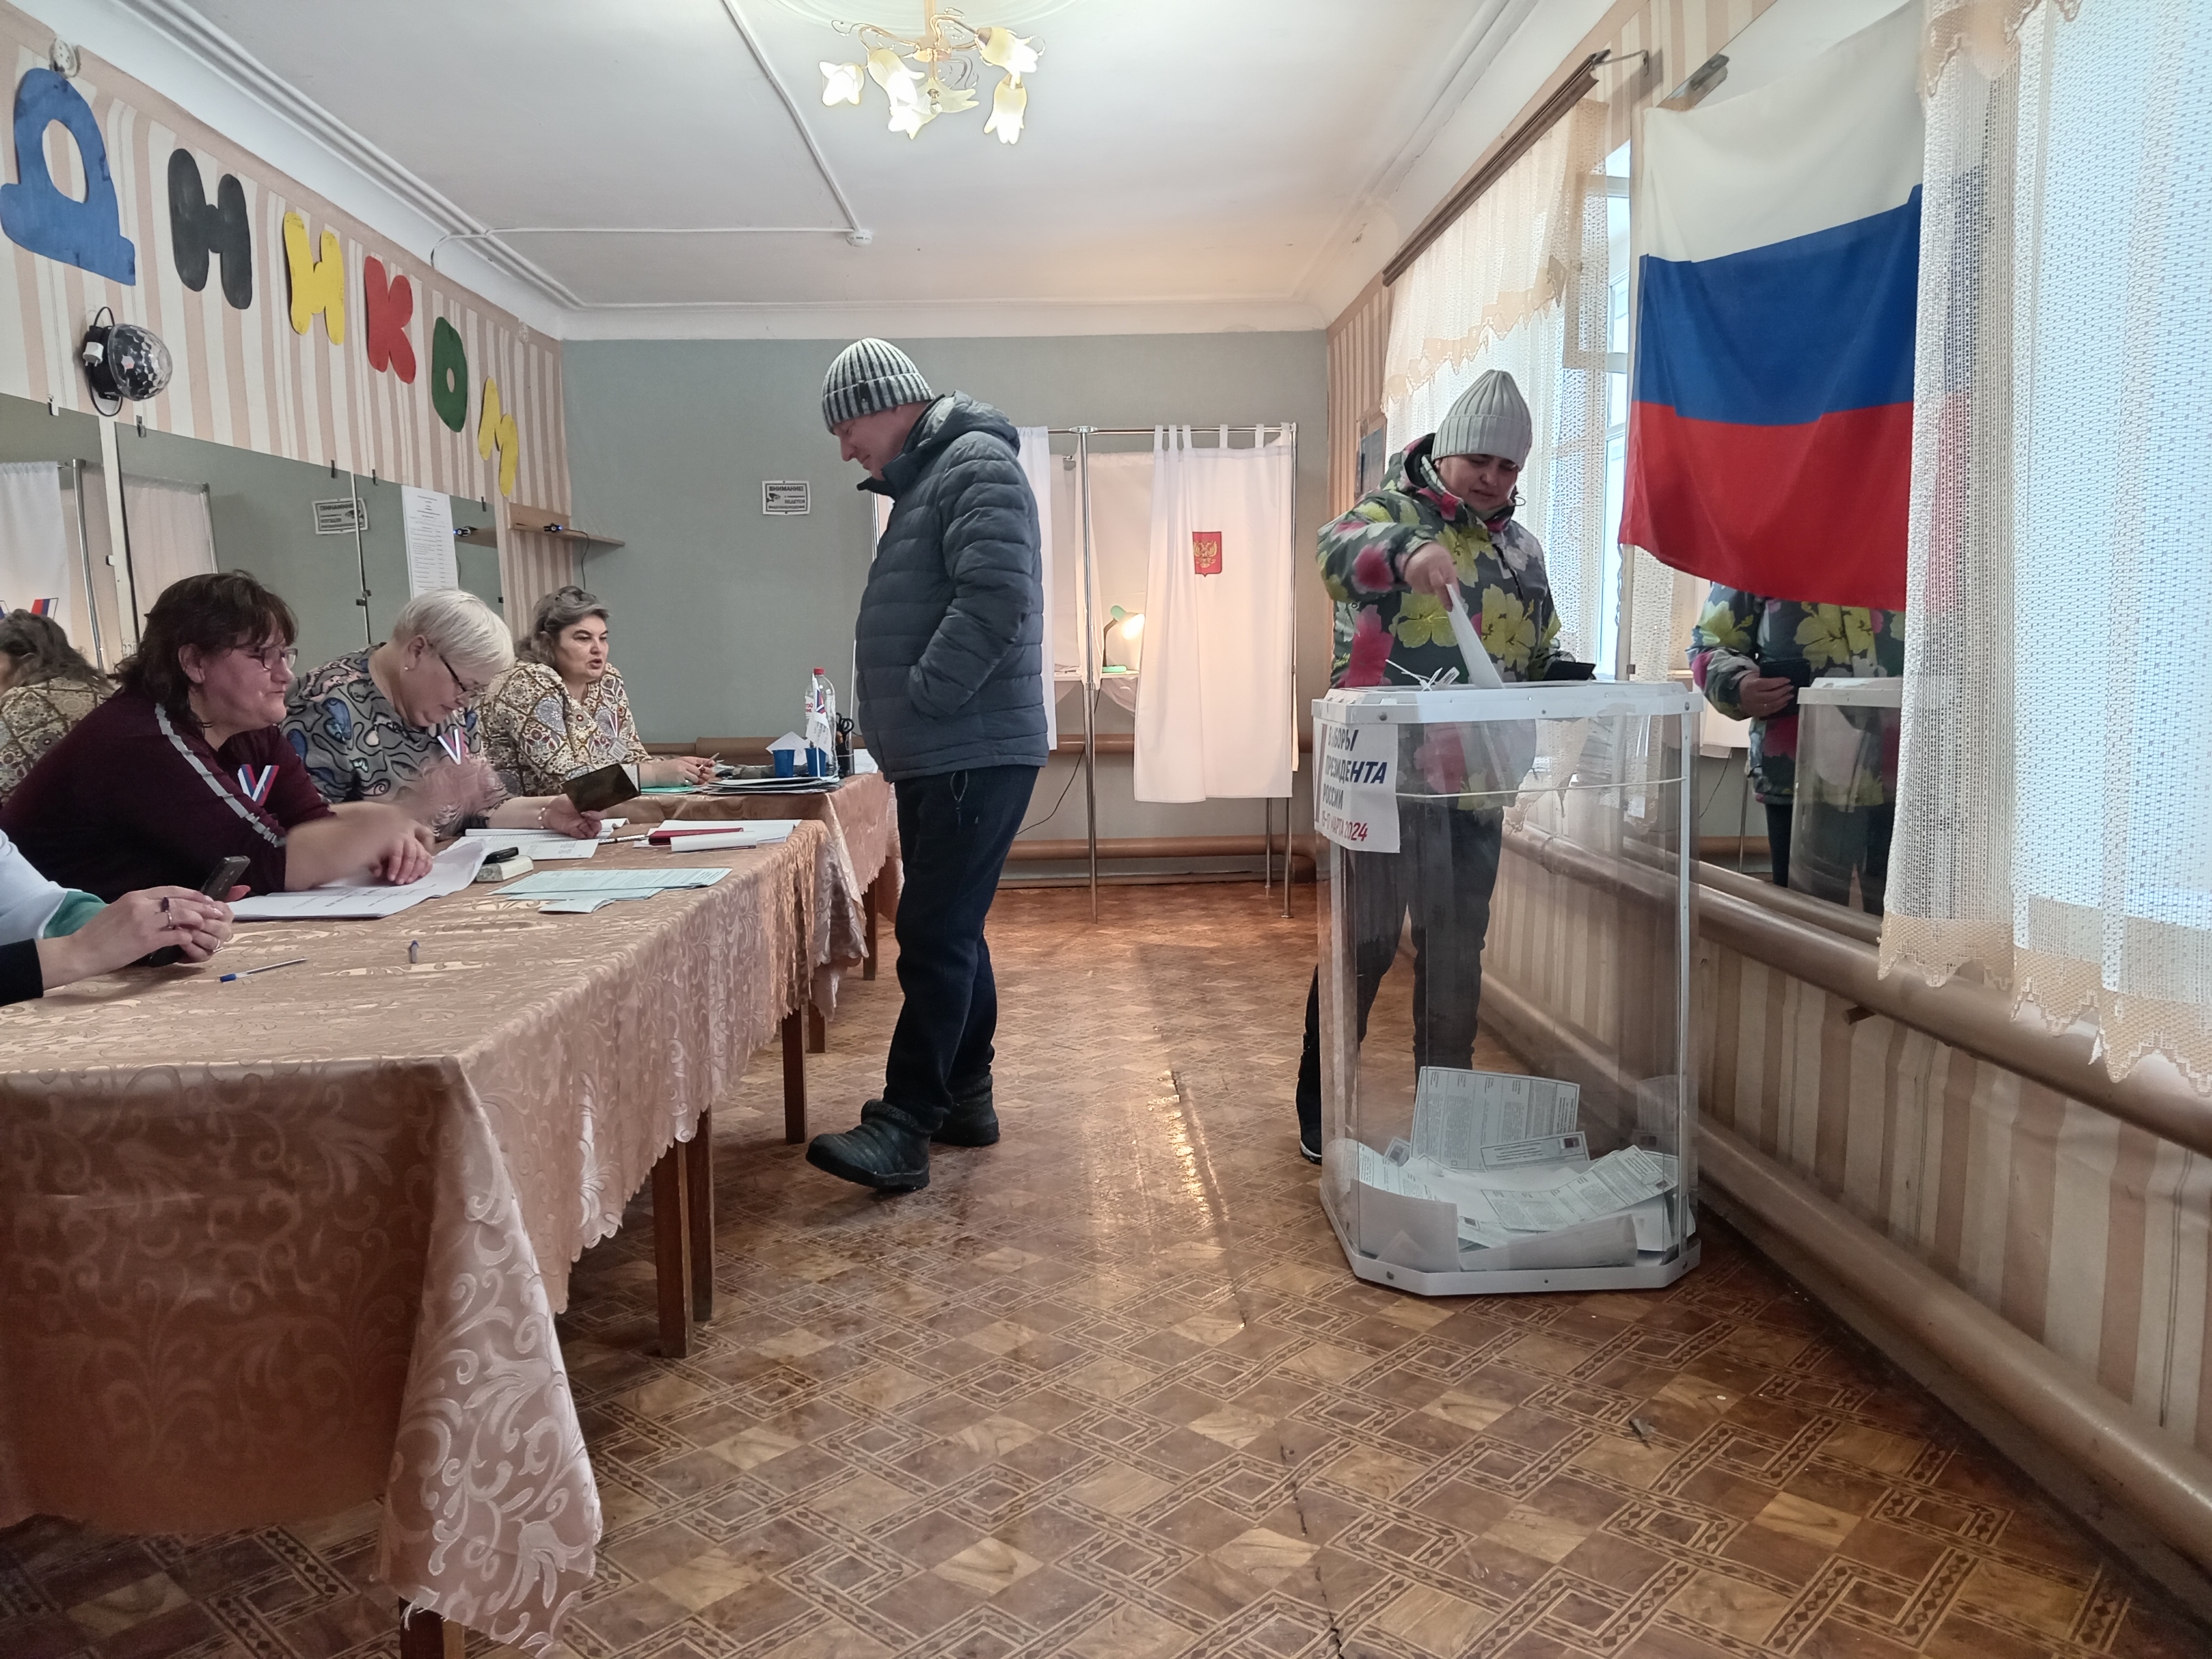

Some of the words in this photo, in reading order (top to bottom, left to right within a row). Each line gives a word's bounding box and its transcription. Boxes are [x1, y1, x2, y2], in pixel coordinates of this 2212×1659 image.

[1328, 726, 1359, 751] ВЫБОРЫ
[1325, 754, 1387, 784] ПРЕЗИДЕНТА
[1323, 783, 1344, 810] РОССИИ
[1344, 820, 1368, 841] 2024
